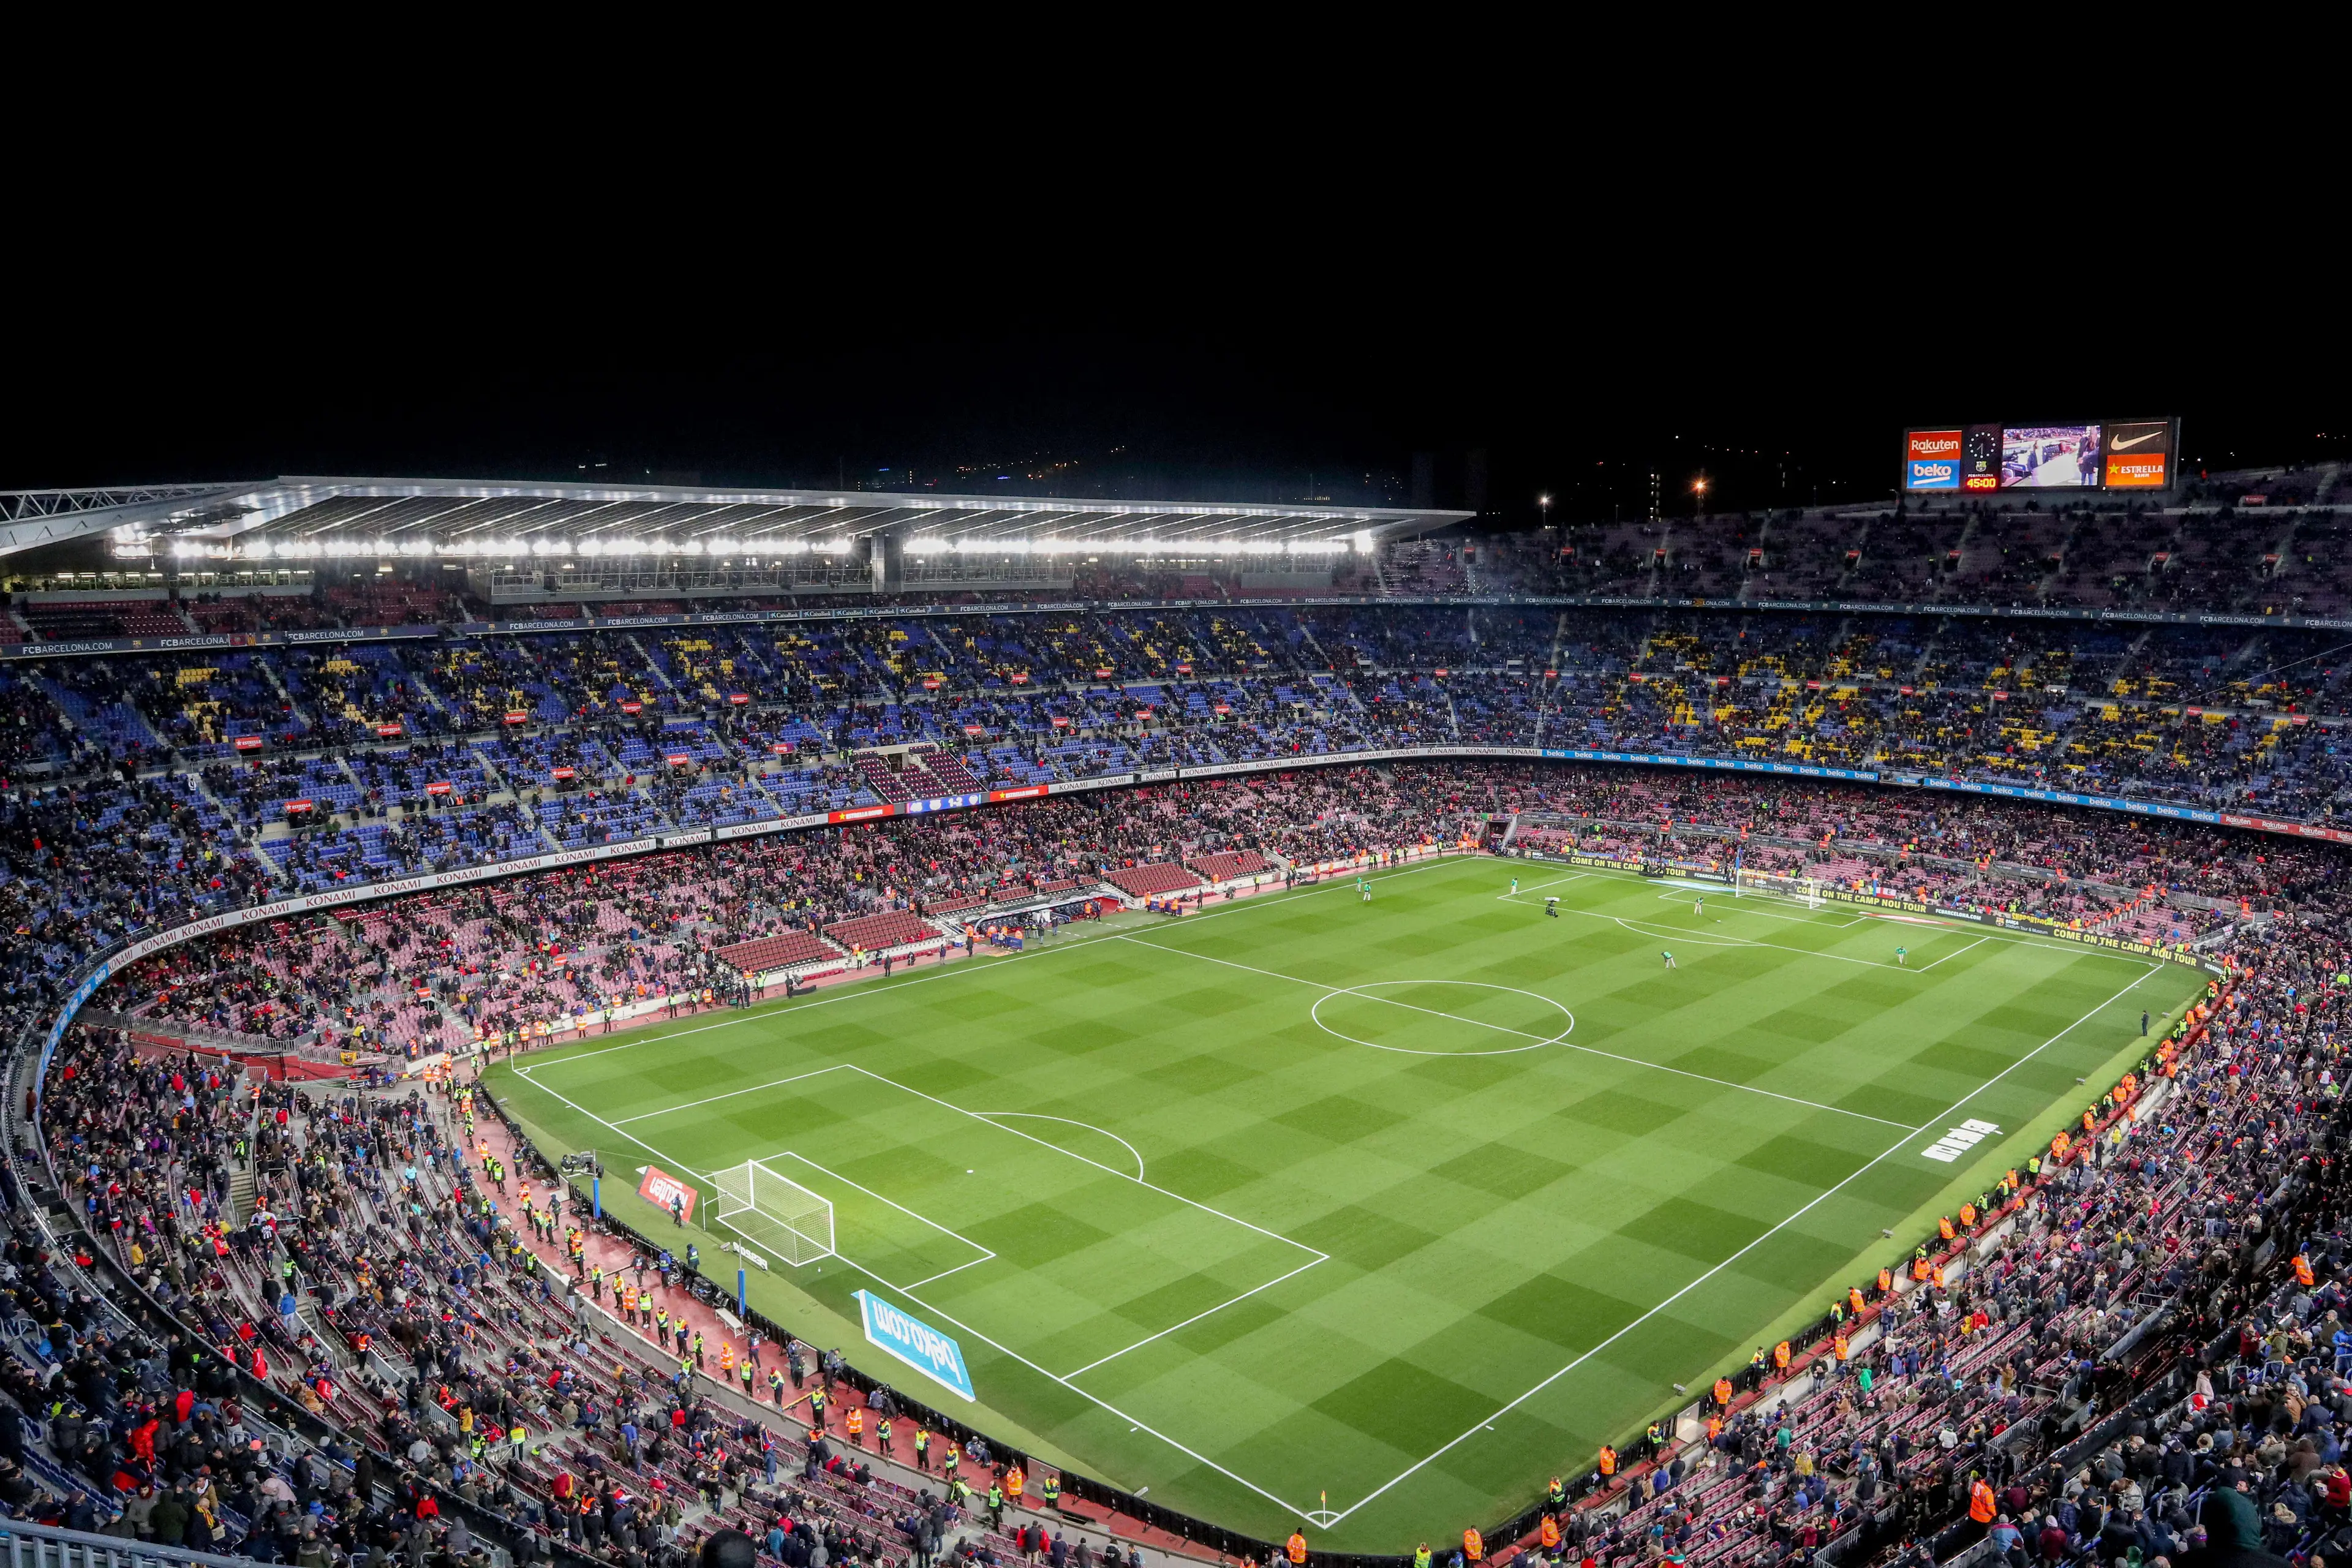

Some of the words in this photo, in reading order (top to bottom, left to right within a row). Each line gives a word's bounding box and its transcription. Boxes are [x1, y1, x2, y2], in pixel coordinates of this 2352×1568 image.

[1911, 439, 1959, 451] Rakuten
[1913, 464, 1952, 477] beko
[2121, 465, 2163, 473] ESTRELLA
[1967, 478, 1996, 488] 45:00
[703, 613, 759, 622] FCBARCELONA.COM
[2101, 612, 2162, 620] FCBARCELONA.COM
[510, 620, 574, 630] FCBARCELONA.COM
[608, 617, 668, 626] FCBARCELONA.COM
[23, 643, 113, 654] FCBARCELONA.COM
[1145, 772, 1174, 781] KONAMI
[1185, 767, 1212, 776] KONAMI
[1059, 782, 1088, 791] KONAMI
[1098, 777, 1126, 786] KONAMI
[1930, 778, 1950, 787] beko
[1961, 782, 1981, 791] beko
[2024, 790, 2045, 798] beko
[2056, 794, 2078, 802] beko
[2089, 797, 2111, 806] beko
[2125, 802, 2148, 812] beko
[2157, 807, 2179, 816] beko
[2191, 812, 2214, 821] beko
[2225, 816, 2252, 825] Rakuten
[780, 817, 816, 828] KONAMI
[2262, 821, 2288, 830] Rakuten
[731, 823, 768, 836] KONAMI
[2299, 826, 2326, 835] Rakuten
[668, 834, 707, 846] KONAMI
[610, 842, 649, 854] KONAMI
[554, 850, 595, 863] KONAMI
[497, 858, 541, 873] KONAMI
[1570, 857, 1593, 866] COME
[1607, 861, 1621, 869] THE
[1665, 867, 1686, 876] TOUR
[436, 869, 482, 884] KONAMI
[373, 880, 421, 895] KONAMI
[306, 891, 355, 908] KONAMI
[1796, 886, 1820, 896] COME
[1836, 892, 1852, 901] THE
[1854, 895, 1880, 905] CAMP
[1882, 899, 1901, 908] NOU
[1903, 902, 1927, 913] TOUR
[241, 902, 289, 921] KONAMI
[1936, 908, 1981, 921] FCBARCELONA.COM
[181, 917, 224, 941] KONAMI
[141, 930, 177, 954] KONAMI
[2054, 929, 2081, 941] COME
[2083, 933, 2098, 944] ON
[2100, 937, 2119, 948] THE
[2121, 942, 2149, 954] CAMP
[2152, 948, 2172, 960] NOU
[2174, 953, 2197, 966] TOUR
[108, 949, 133, 972] KONAMI
[872, 1300, 963, 1385] beko.com
[1720, 1525, 1727, 1534] 9
